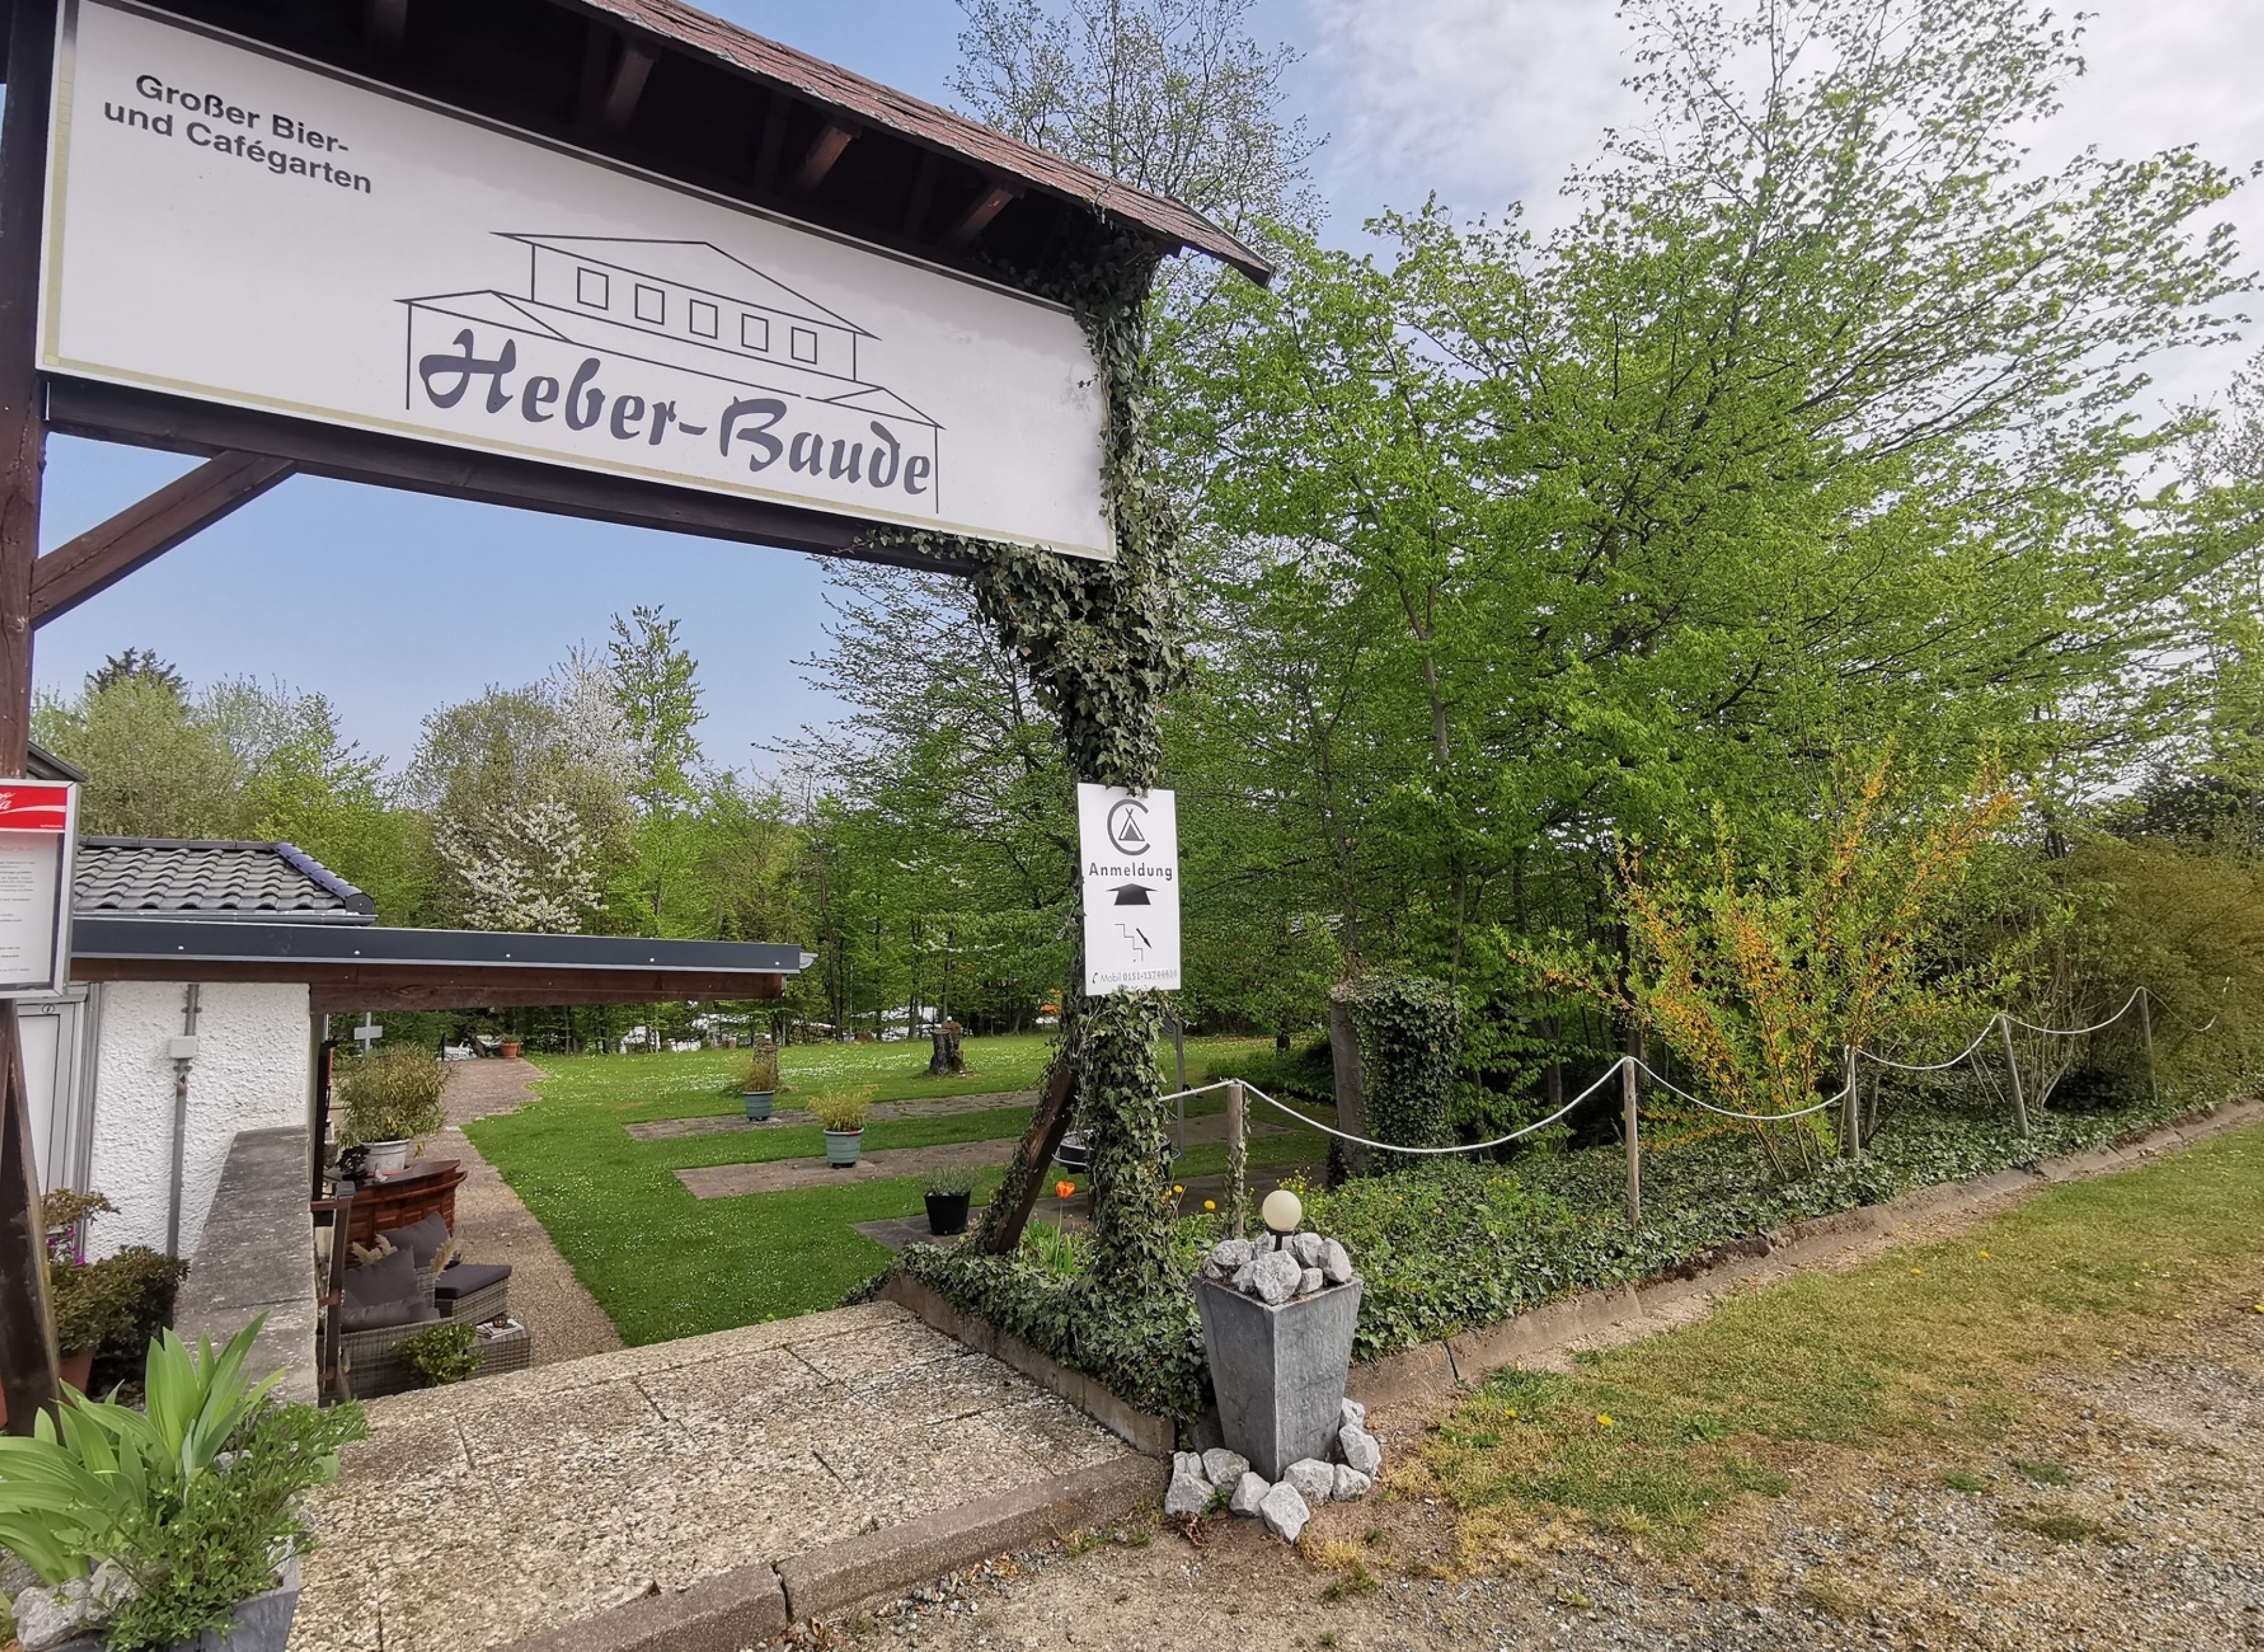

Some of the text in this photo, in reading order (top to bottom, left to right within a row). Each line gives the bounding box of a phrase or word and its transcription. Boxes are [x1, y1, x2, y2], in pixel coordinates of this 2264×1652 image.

[104, 102, 371, 194] und Cafégarten
[136, 74, 349, 152] Großer Bier-
[419, 329, 930, 495] Heber-Baude
[1089, 862, 1173, 881] Anmeldung
[1101, 972, 1122, 983] Mobil
